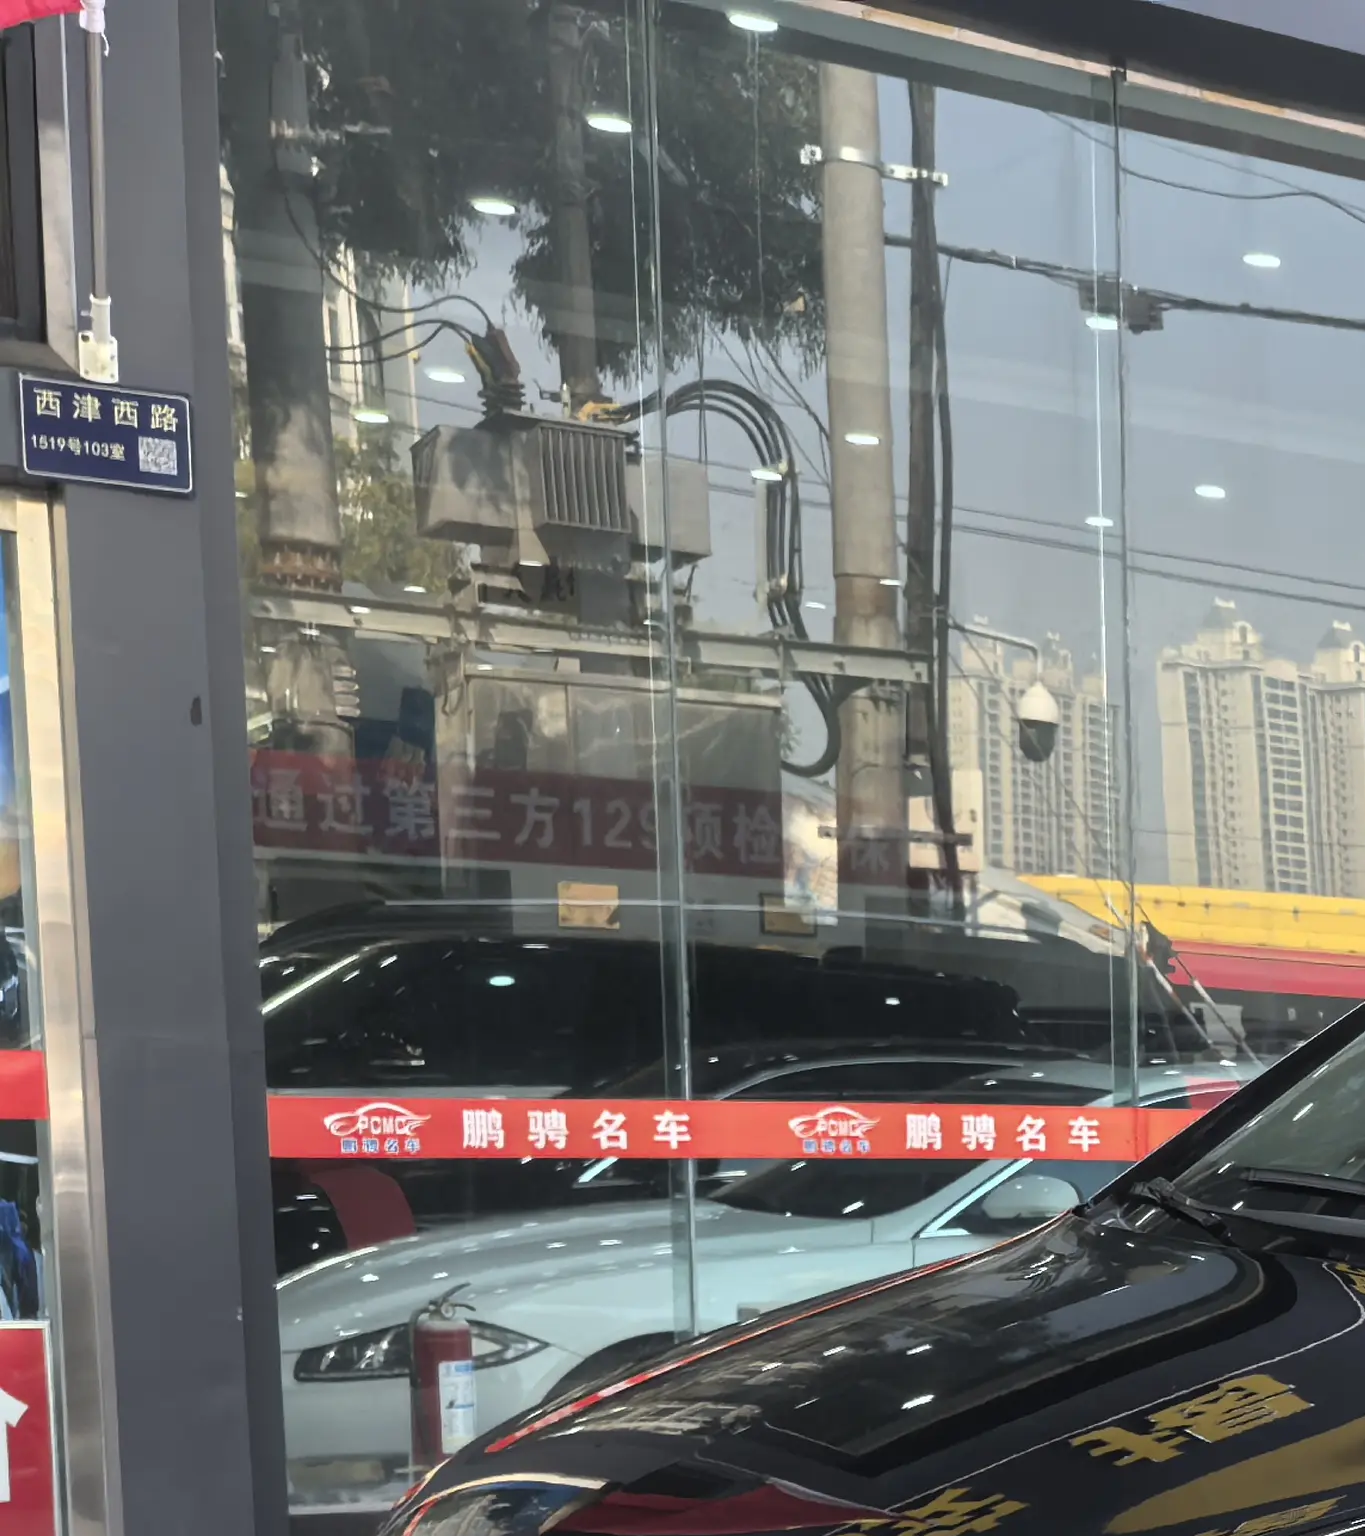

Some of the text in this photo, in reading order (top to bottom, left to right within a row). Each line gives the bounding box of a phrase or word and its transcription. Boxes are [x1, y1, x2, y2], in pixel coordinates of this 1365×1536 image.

[33, 387, 179, 433] 西津西路
[30, 433, 127, 462] 1519号103室
[462, 1108, 692, 1150] 鹏骋名车
[905, 1112, 1101, 1153] 鹏骋名车
